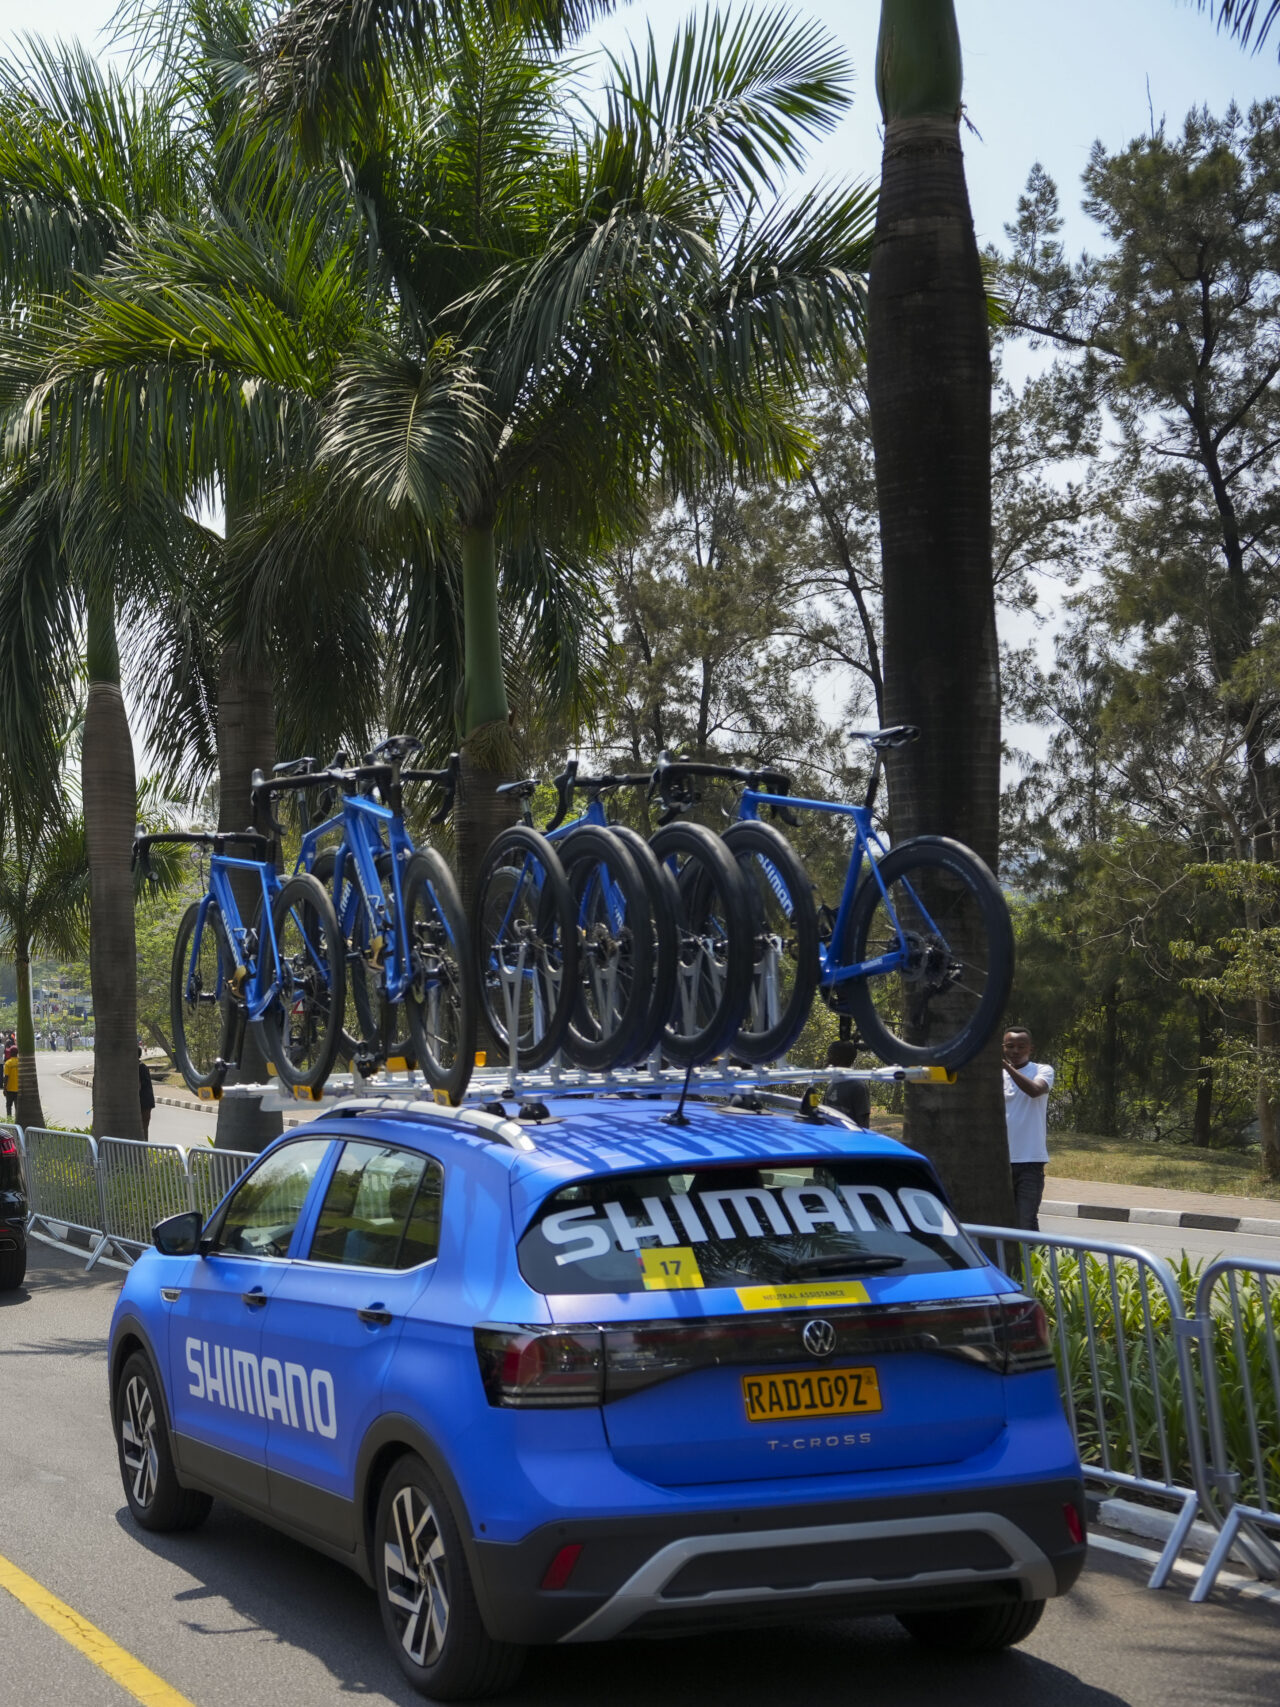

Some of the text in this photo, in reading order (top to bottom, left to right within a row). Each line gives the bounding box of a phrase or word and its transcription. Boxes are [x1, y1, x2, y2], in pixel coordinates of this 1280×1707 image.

[541, 1184, 959, 1266] SHIMANO
[660, 1259, 682, 1276] 17
[763, 1290, 845, 1301] NEUTRAL ASSISTANCE
[186, 1336, 337, 1440] SHIMANO
[747, 1374, 868, 1414] RAD109Z
[767, 1433, 872, 1451] T-CROSS
